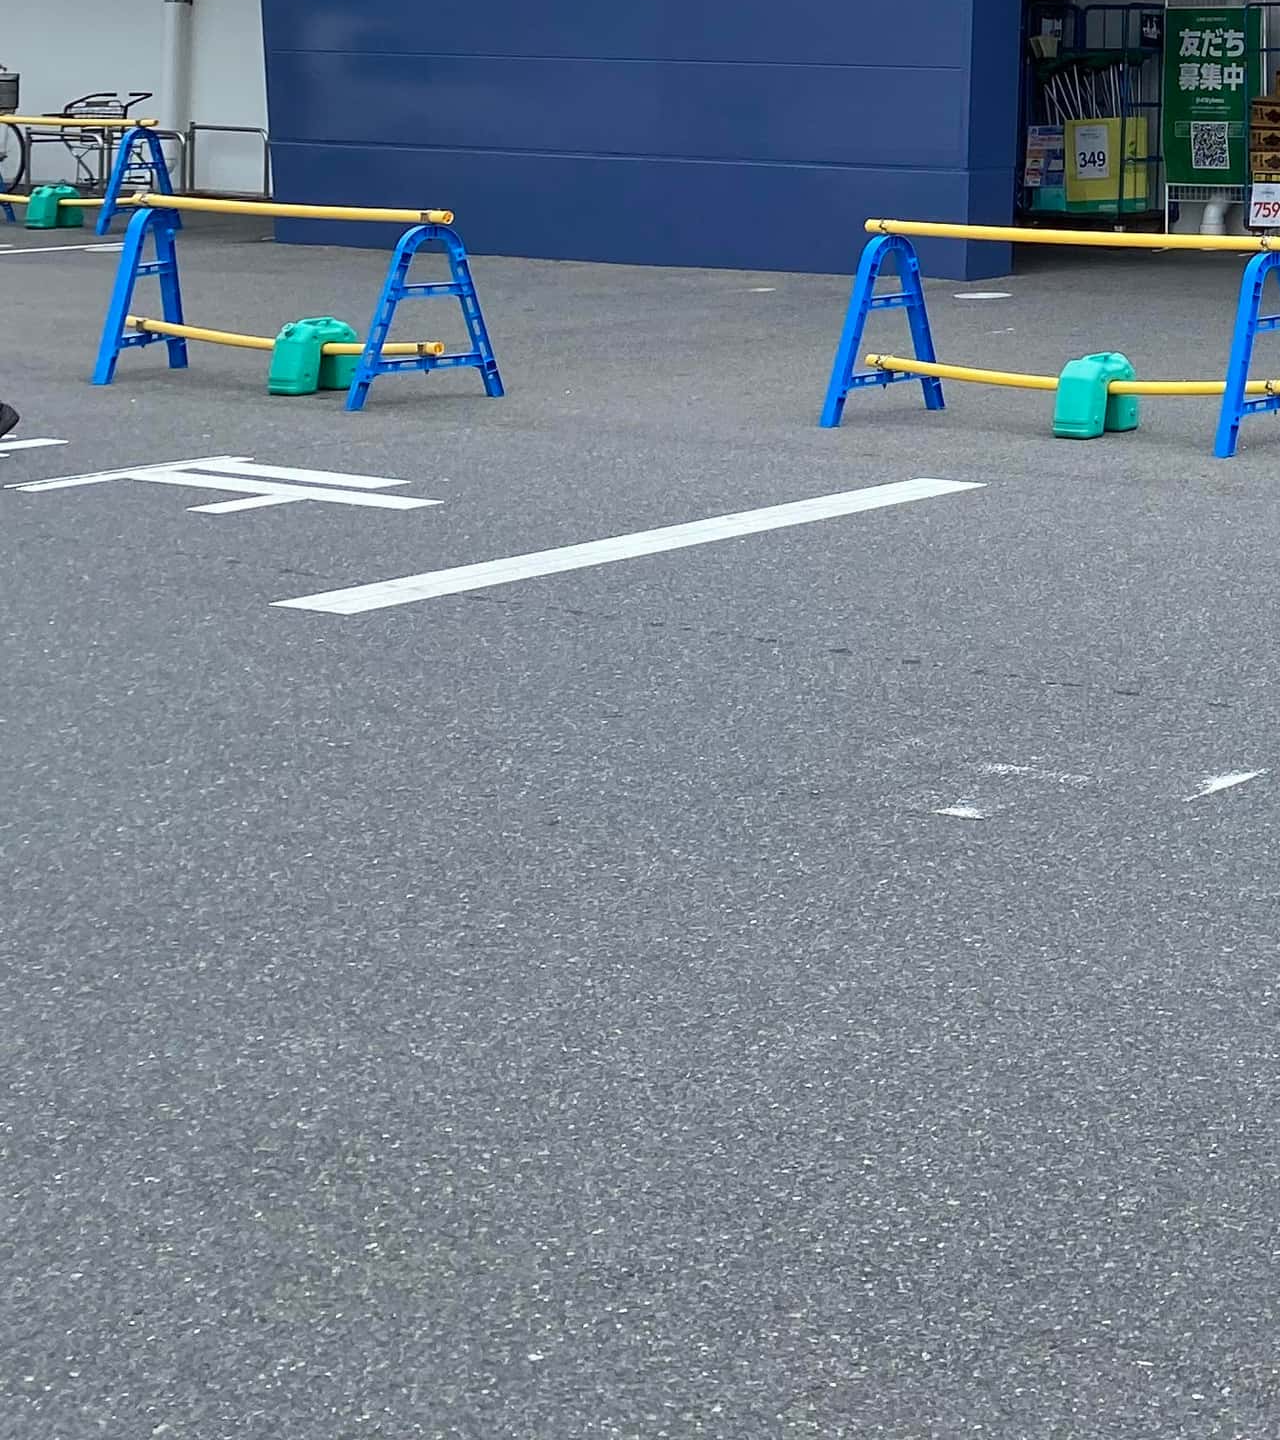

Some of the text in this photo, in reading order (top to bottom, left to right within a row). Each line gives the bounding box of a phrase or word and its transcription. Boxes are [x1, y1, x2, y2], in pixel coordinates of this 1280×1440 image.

[1179, 28, 1245, 57] 友だち
[1178, 62, 1244, 91] 募集中
[1078, 151, 1106, 168] 349
[1253, 201, 1280, 218] 759
